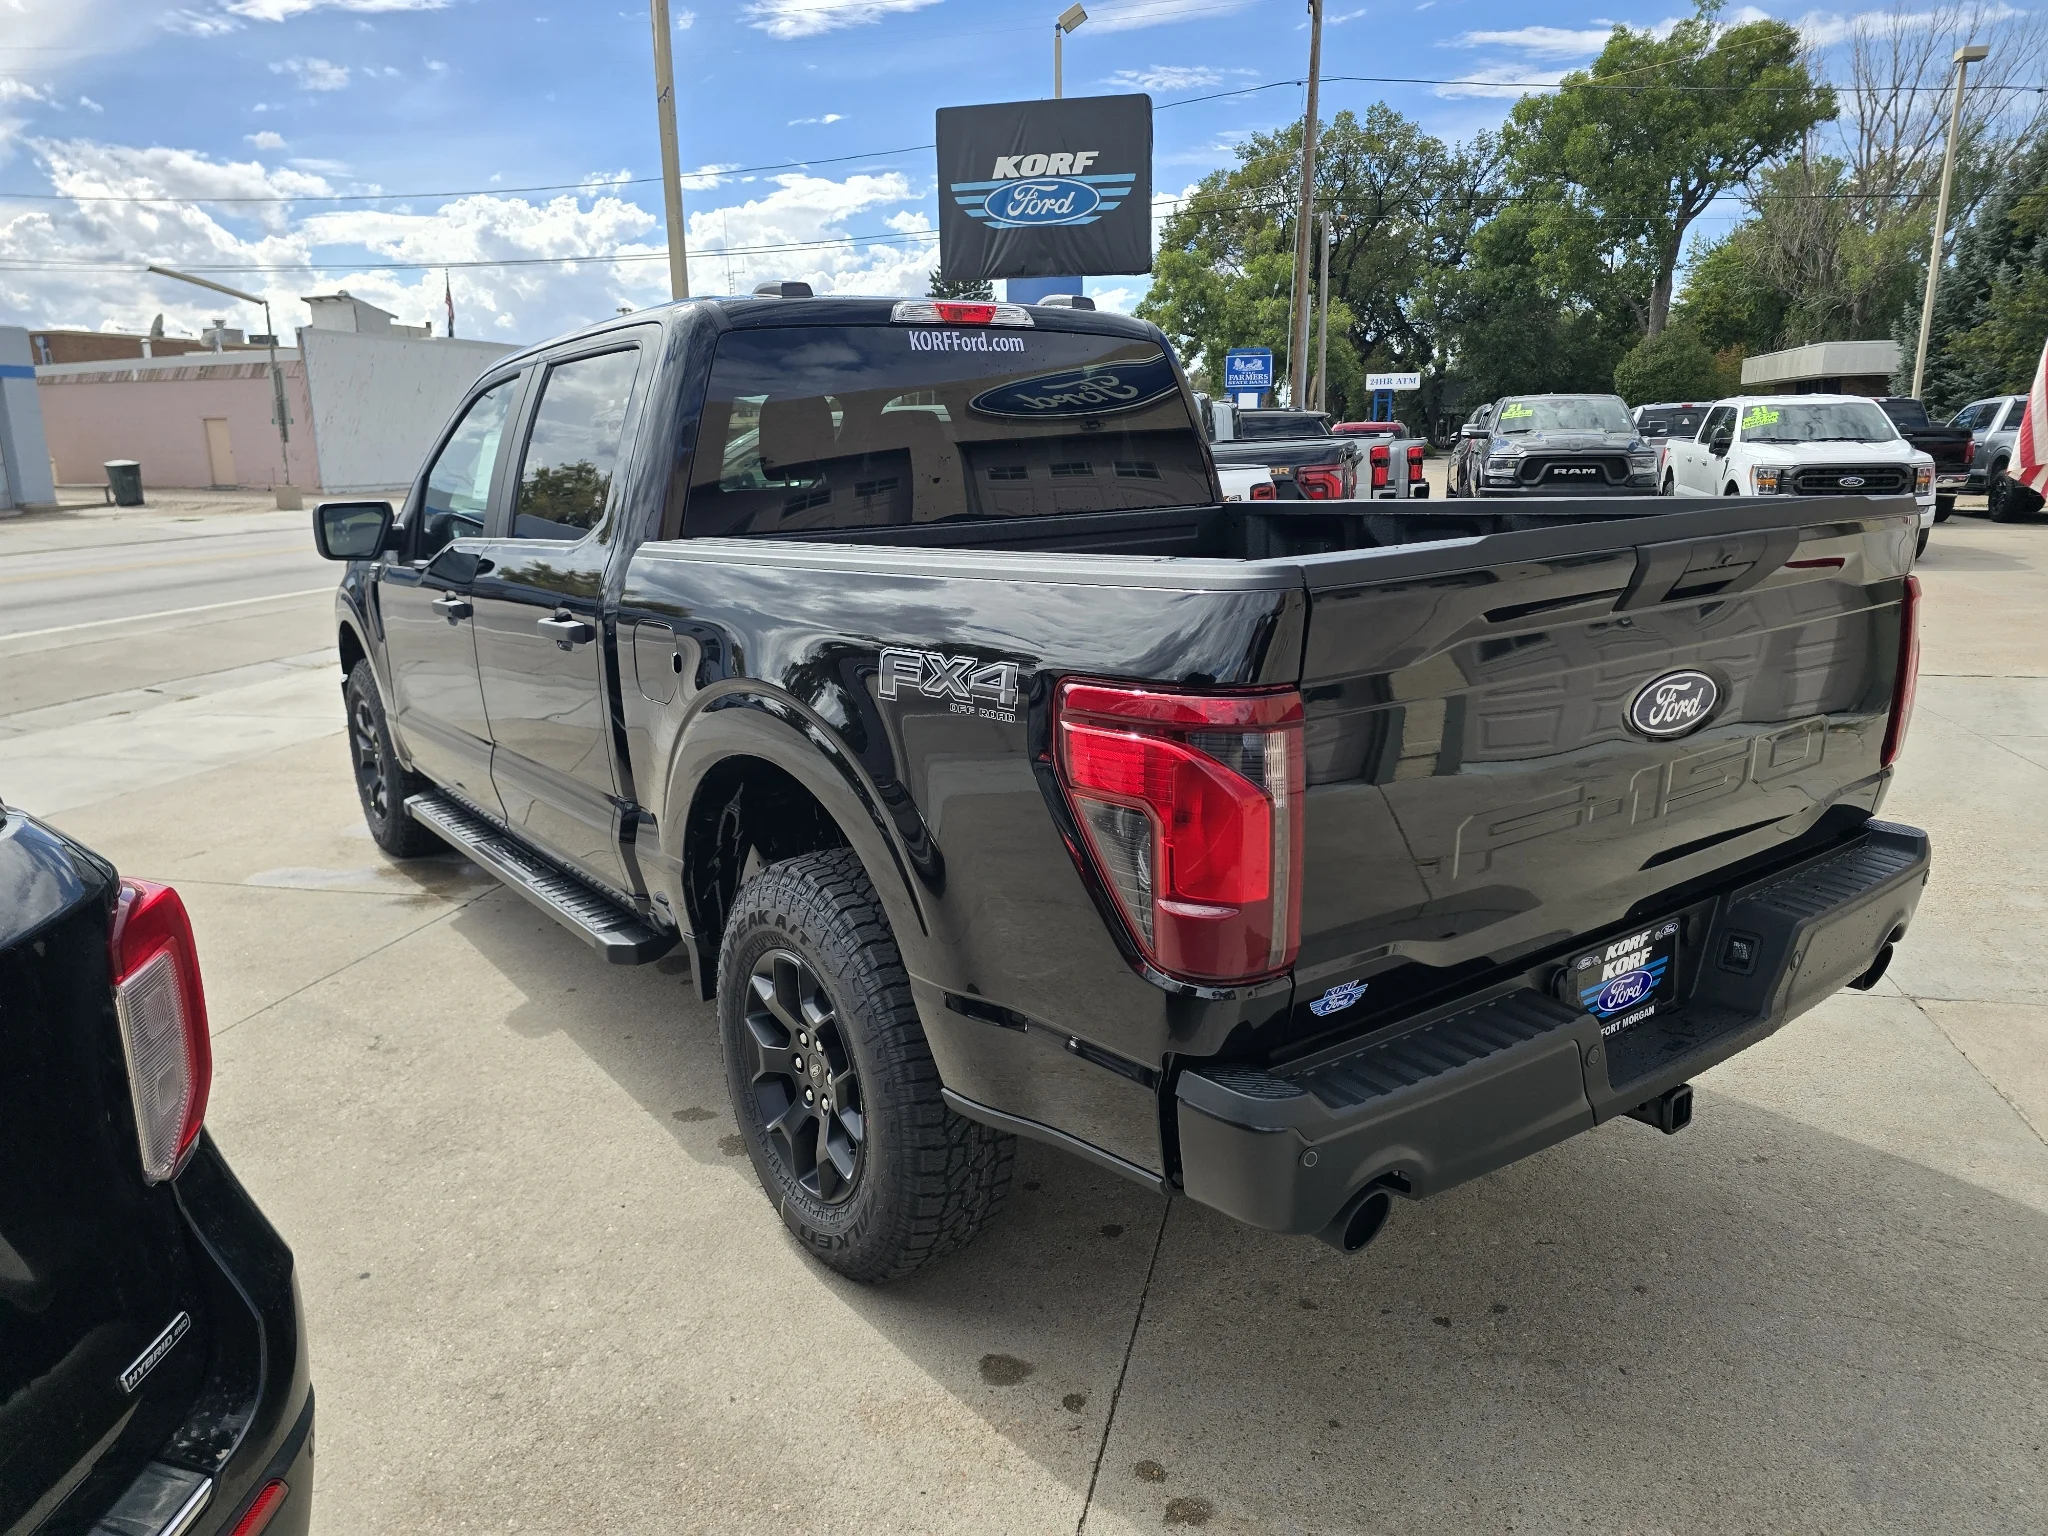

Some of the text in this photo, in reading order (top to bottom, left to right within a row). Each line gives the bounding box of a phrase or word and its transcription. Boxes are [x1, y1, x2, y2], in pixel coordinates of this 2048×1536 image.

[992, 151, 1099, 180] KORF
[1007, 184, 1076, 217] Ford
[908, 331, 1025, 352] KORFFord.com
[1229, 373, 1269, 382] FARMERS
[1370, 376, 1417, 386] 24HR ATM
[877, 646, 1020, 711] FX4
[950, 702, 1016, 723] OFF ROAD
[1649, 681, 1704, 726] Ford
[1605, 930, 1651, 961] KORF
[1602, 946, 1653, 982] KORF
[1325, 980, 1358, 997] KORF
[1325, 994, 1351, 1010] Ford
[1607, 975, 1644, 1008] Ford
[1600, 1005, 1655, 1036] FORT MORGAN
[128, 1318, 188, 1386] HYBRID 4WD
